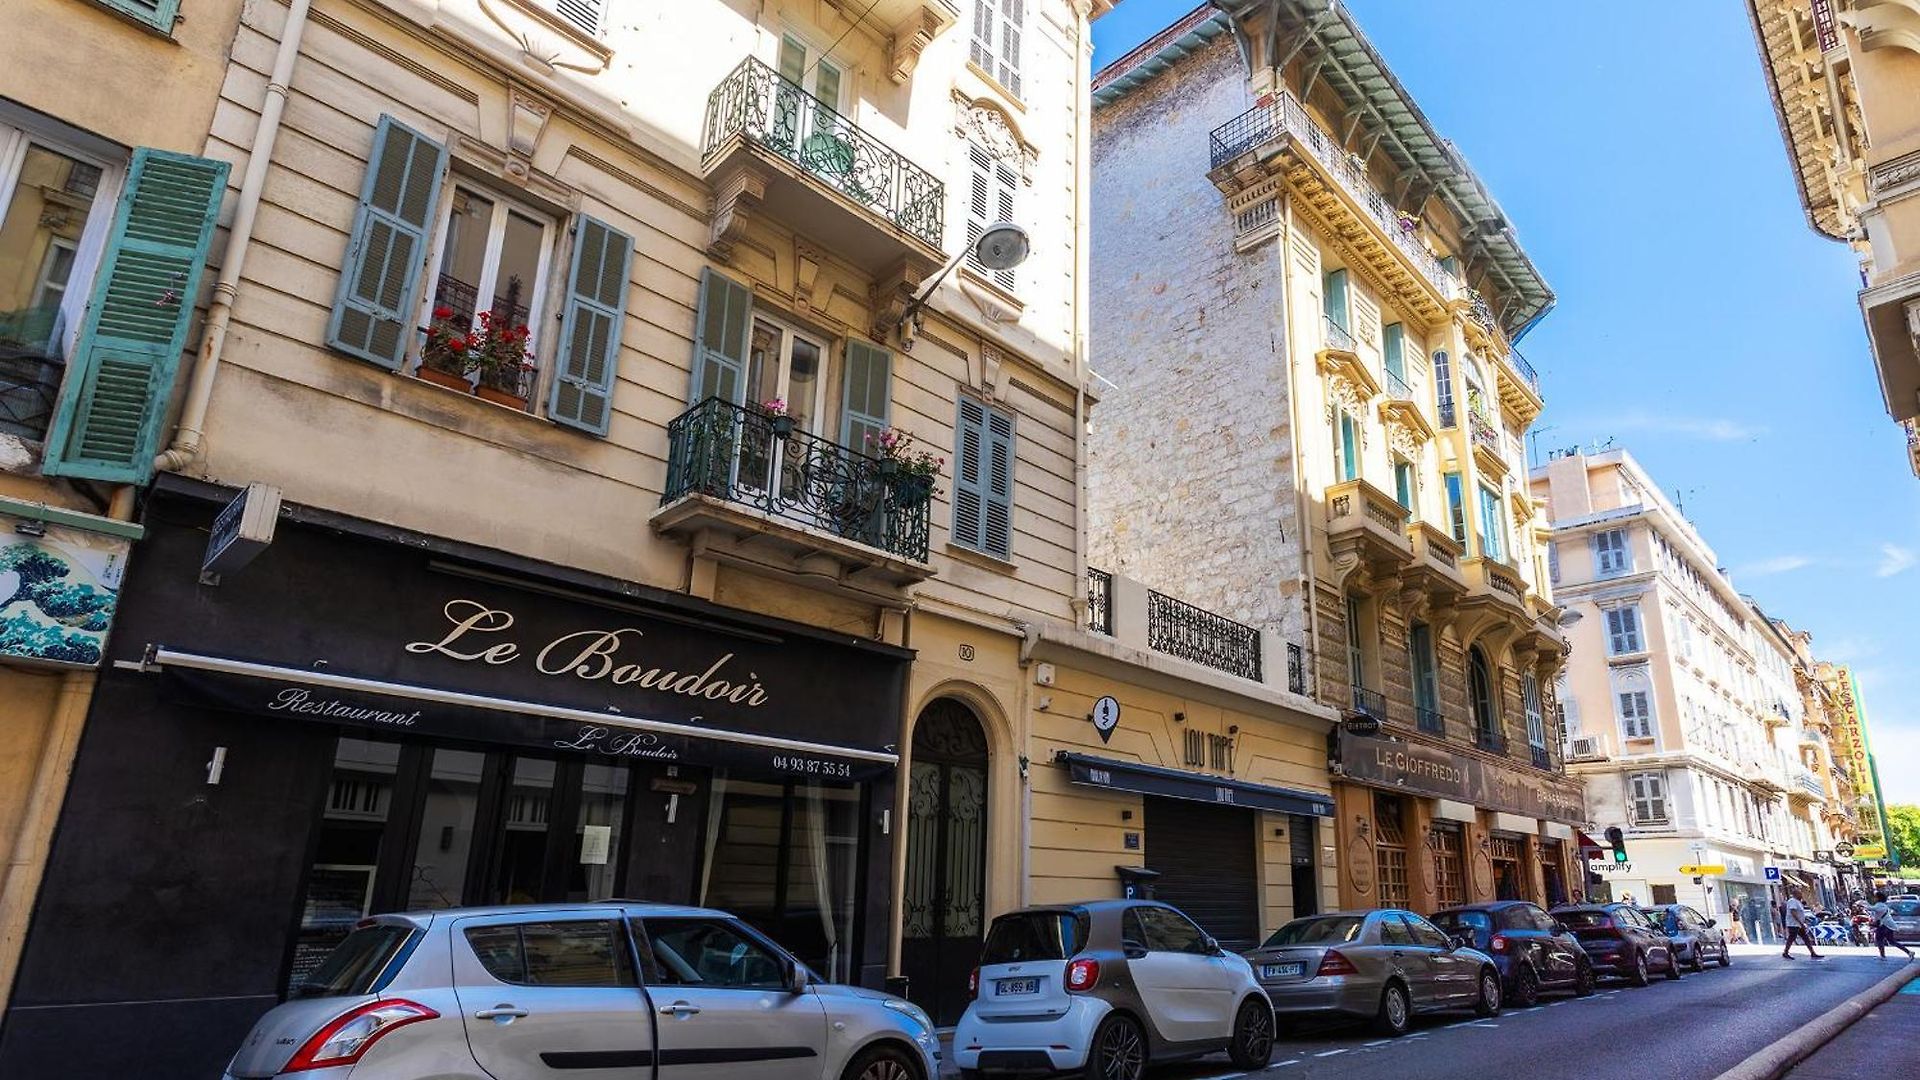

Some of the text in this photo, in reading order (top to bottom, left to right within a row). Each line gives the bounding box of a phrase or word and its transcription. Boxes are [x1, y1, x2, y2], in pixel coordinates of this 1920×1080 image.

[405, 599, 768, 706] Le Boudoir
[268, 688, 421, 726] Restaurant
[554, 725, 679, 760] Le Boudoir
[1184, 728, 1234, 774] LOU TAPE
[773, 755, 850, 777] 04 93 87 55 54
[1376, 747, 1460, 784] LE GIOFFREDO
[1590, 861, 1632, 873] amplify
[1768, 869, 1775, 877] P
[1126, 886, 1134, 900] P
